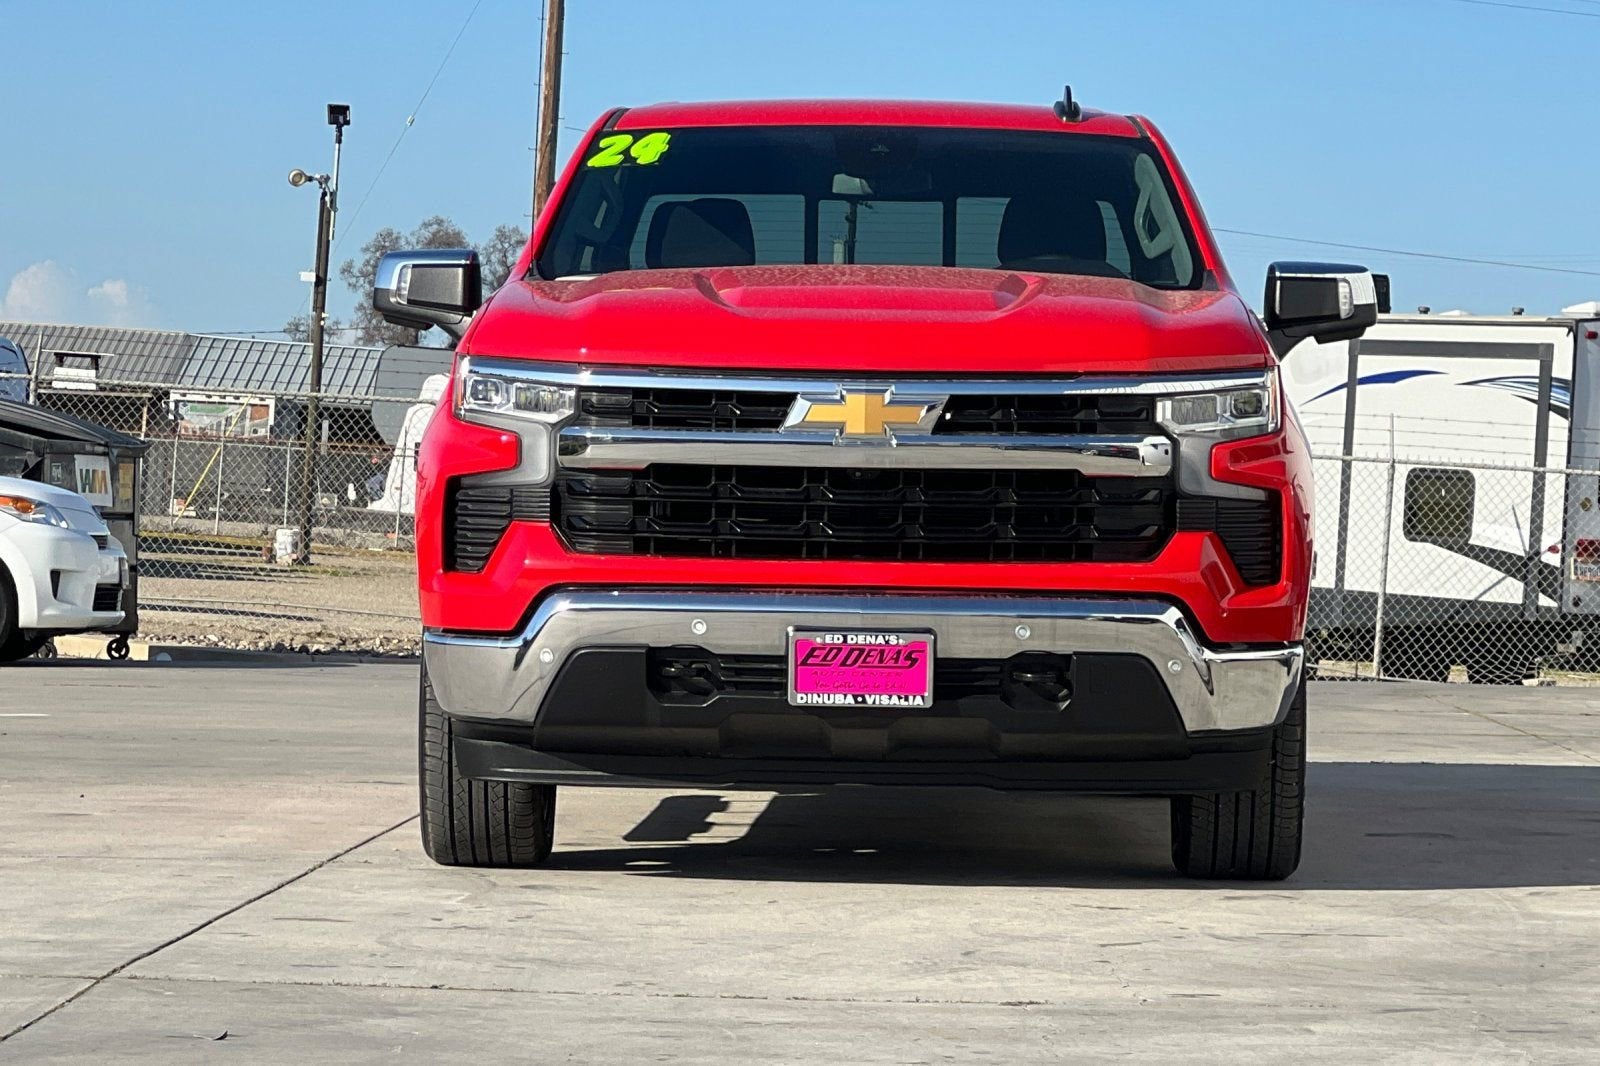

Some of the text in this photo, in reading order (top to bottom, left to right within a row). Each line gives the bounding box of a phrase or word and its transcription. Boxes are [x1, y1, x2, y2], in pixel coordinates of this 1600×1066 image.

[587, 132, 671, 167] 24
[79, 468, 109, 494] WM
[824, 634, 899, 645] ED DENA'S
[799, 646, 844, 667] ED
[796, 693, 924, 705] DINUBA VISALIA
